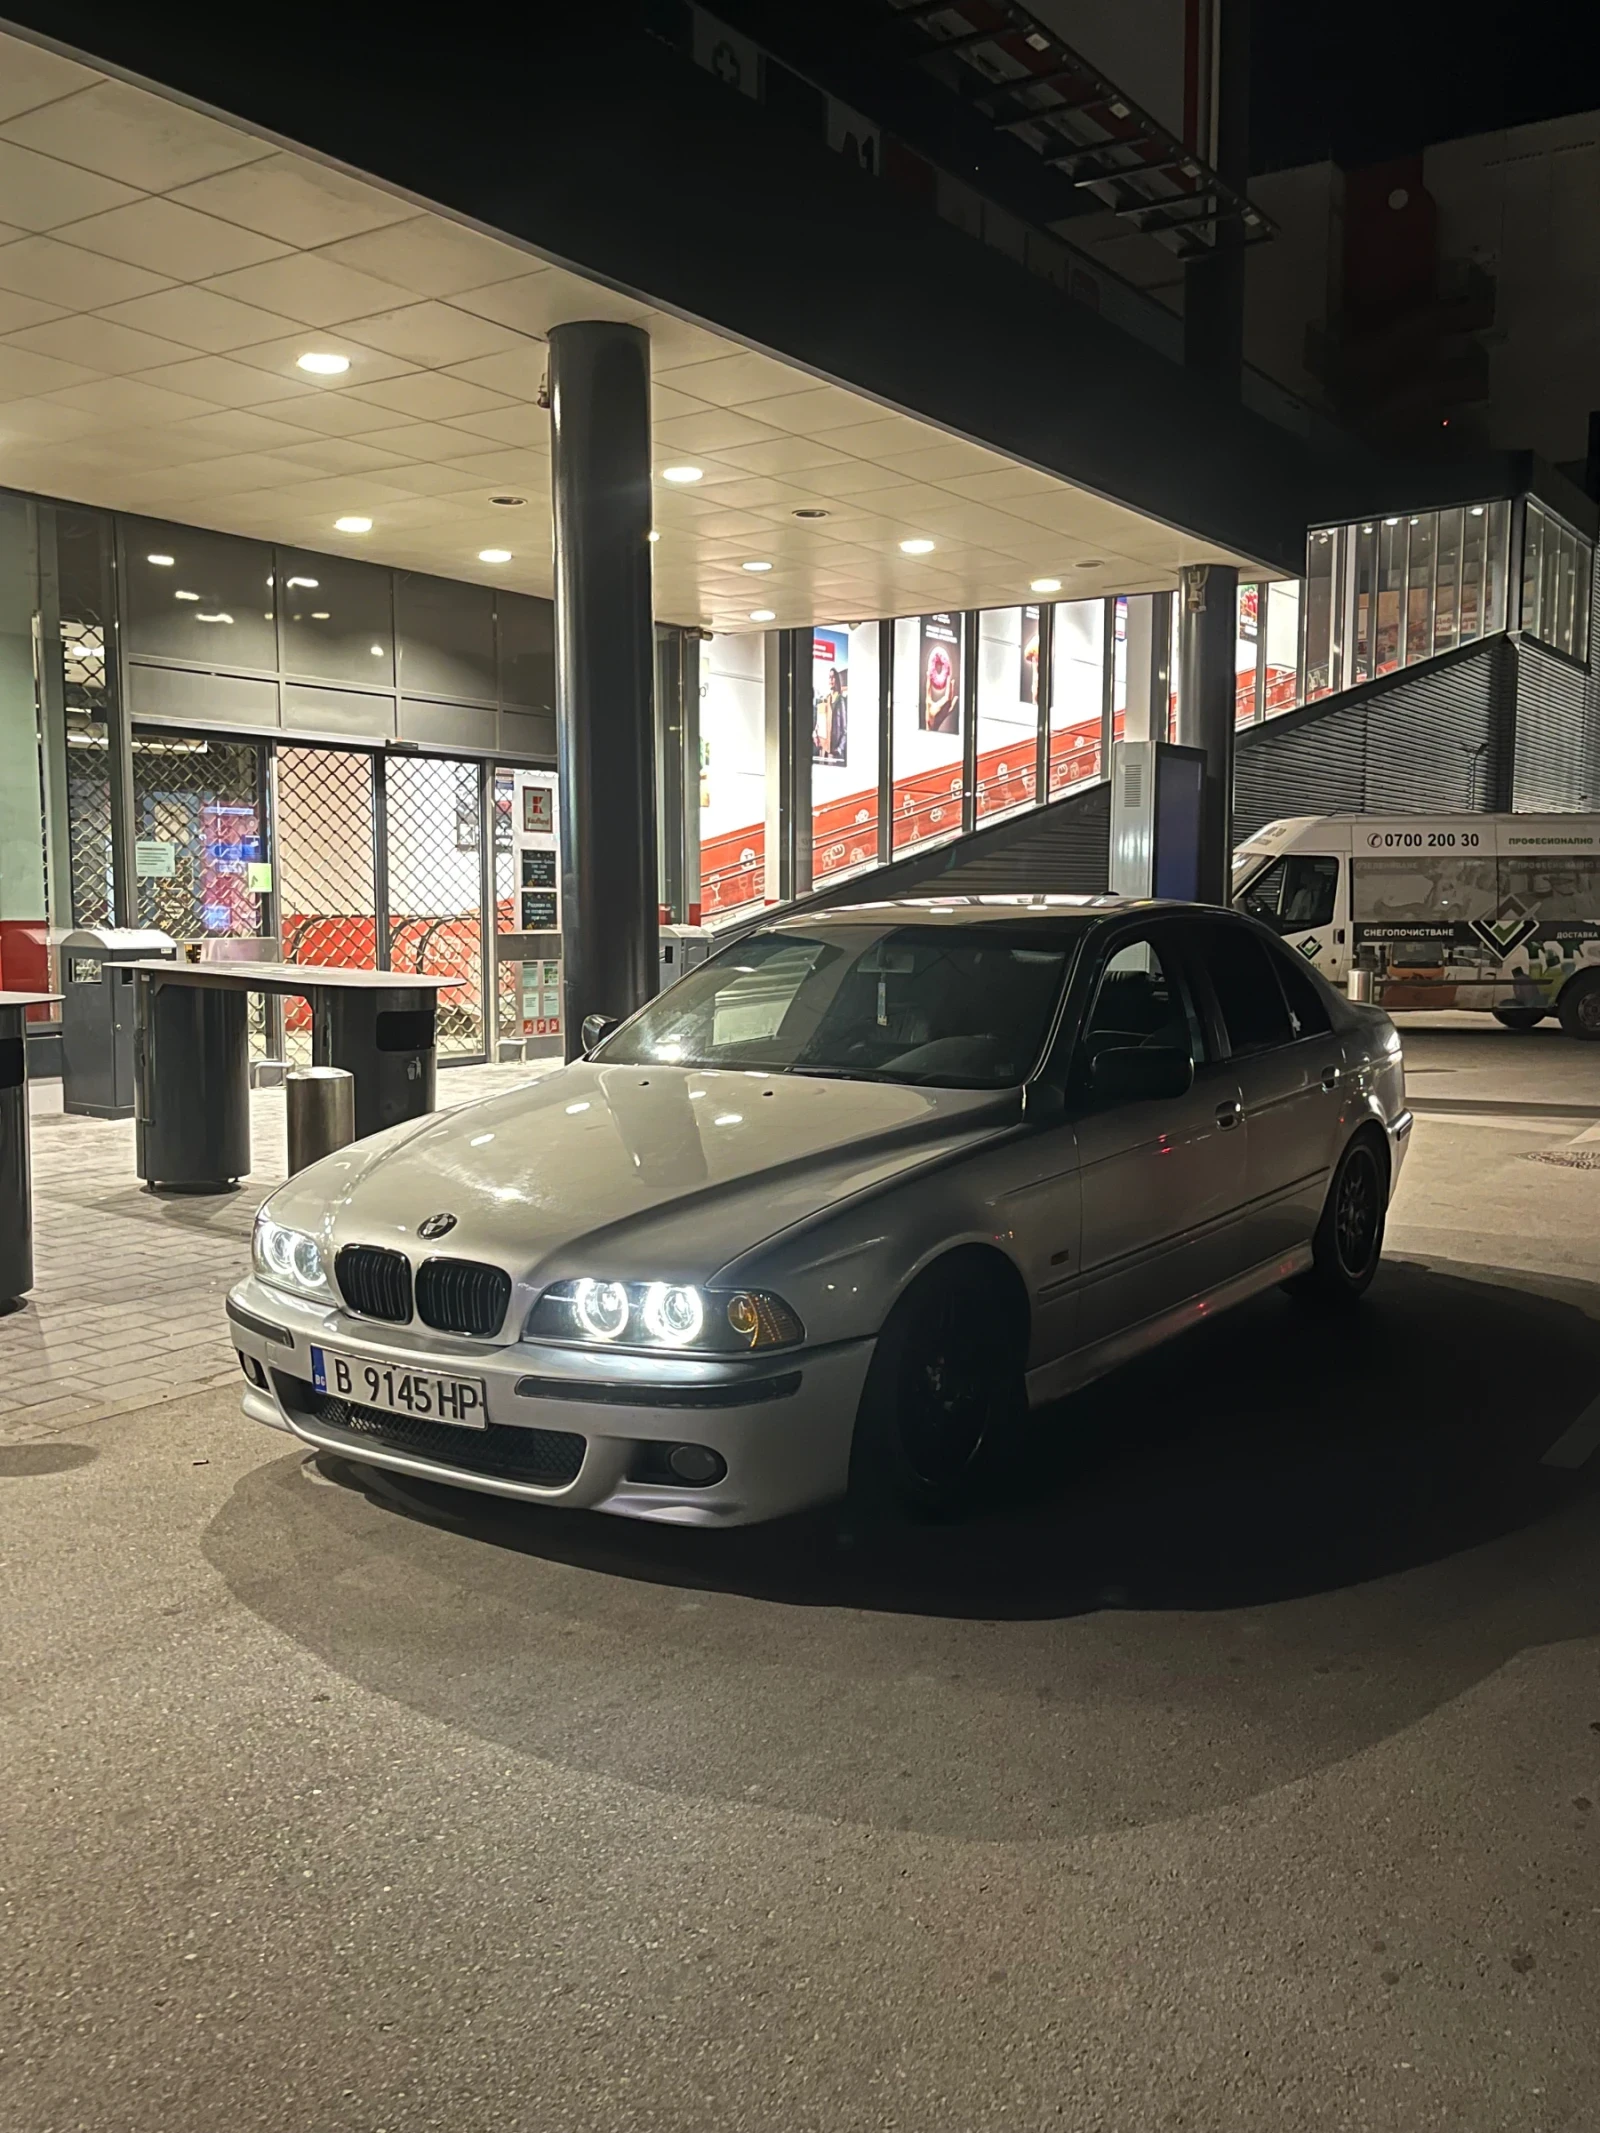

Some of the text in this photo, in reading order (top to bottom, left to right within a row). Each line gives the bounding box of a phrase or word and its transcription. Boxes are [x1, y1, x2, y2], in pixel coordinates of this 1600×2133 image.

[1385, 833, 1479, 847] 0700 200 30
[1508, 837, 1594, 845] ПРОФЕСИОНАЛНО
[1363, 928, 1455, 937] СНЕГОПОЧИСТВАНЕ
[1556, 931, 1598, 940] ДОСТАВКА
[315, 1374, 326, 1387] BG
[334, 1358, 353, 1394] B
